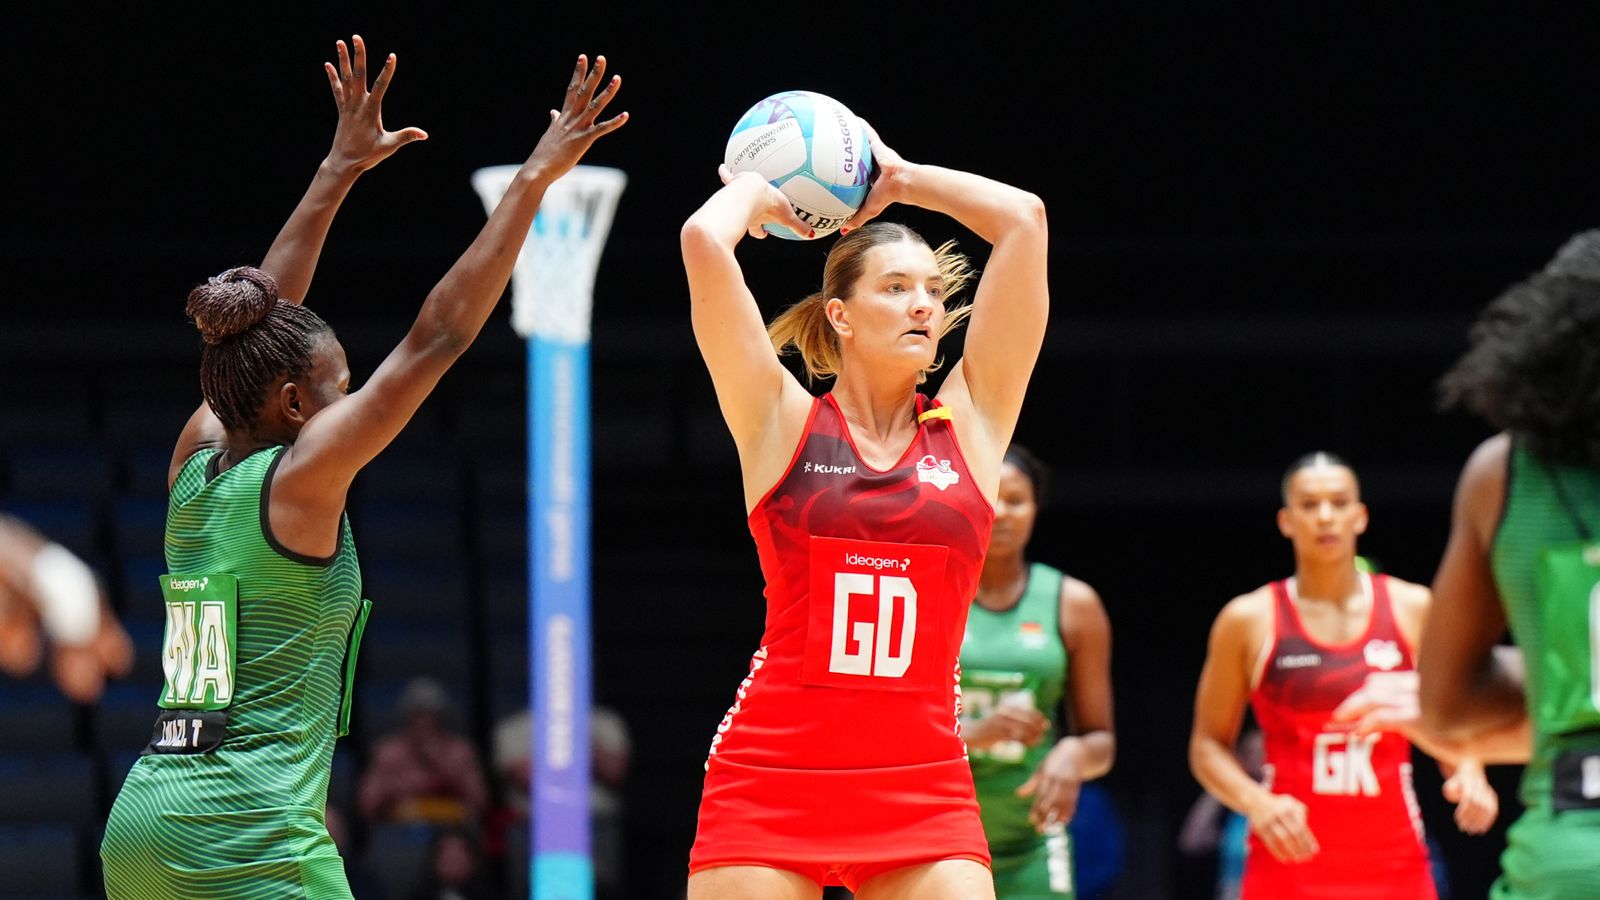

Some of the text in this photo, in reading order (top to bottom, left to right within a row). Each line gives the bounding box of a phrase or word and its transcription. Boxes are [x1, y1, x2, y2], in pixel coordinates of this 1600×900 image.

[748, 136, 777, 161] games
[814, 463, 856, 475] KUKRI
[845, 552, 899, 570] Ideagen
[829, 572, 918, 678] GD
[163, 601, 233, 703] WA
[192, 719, 203, 747] T
[1313, 732, 1383, 798] GK
